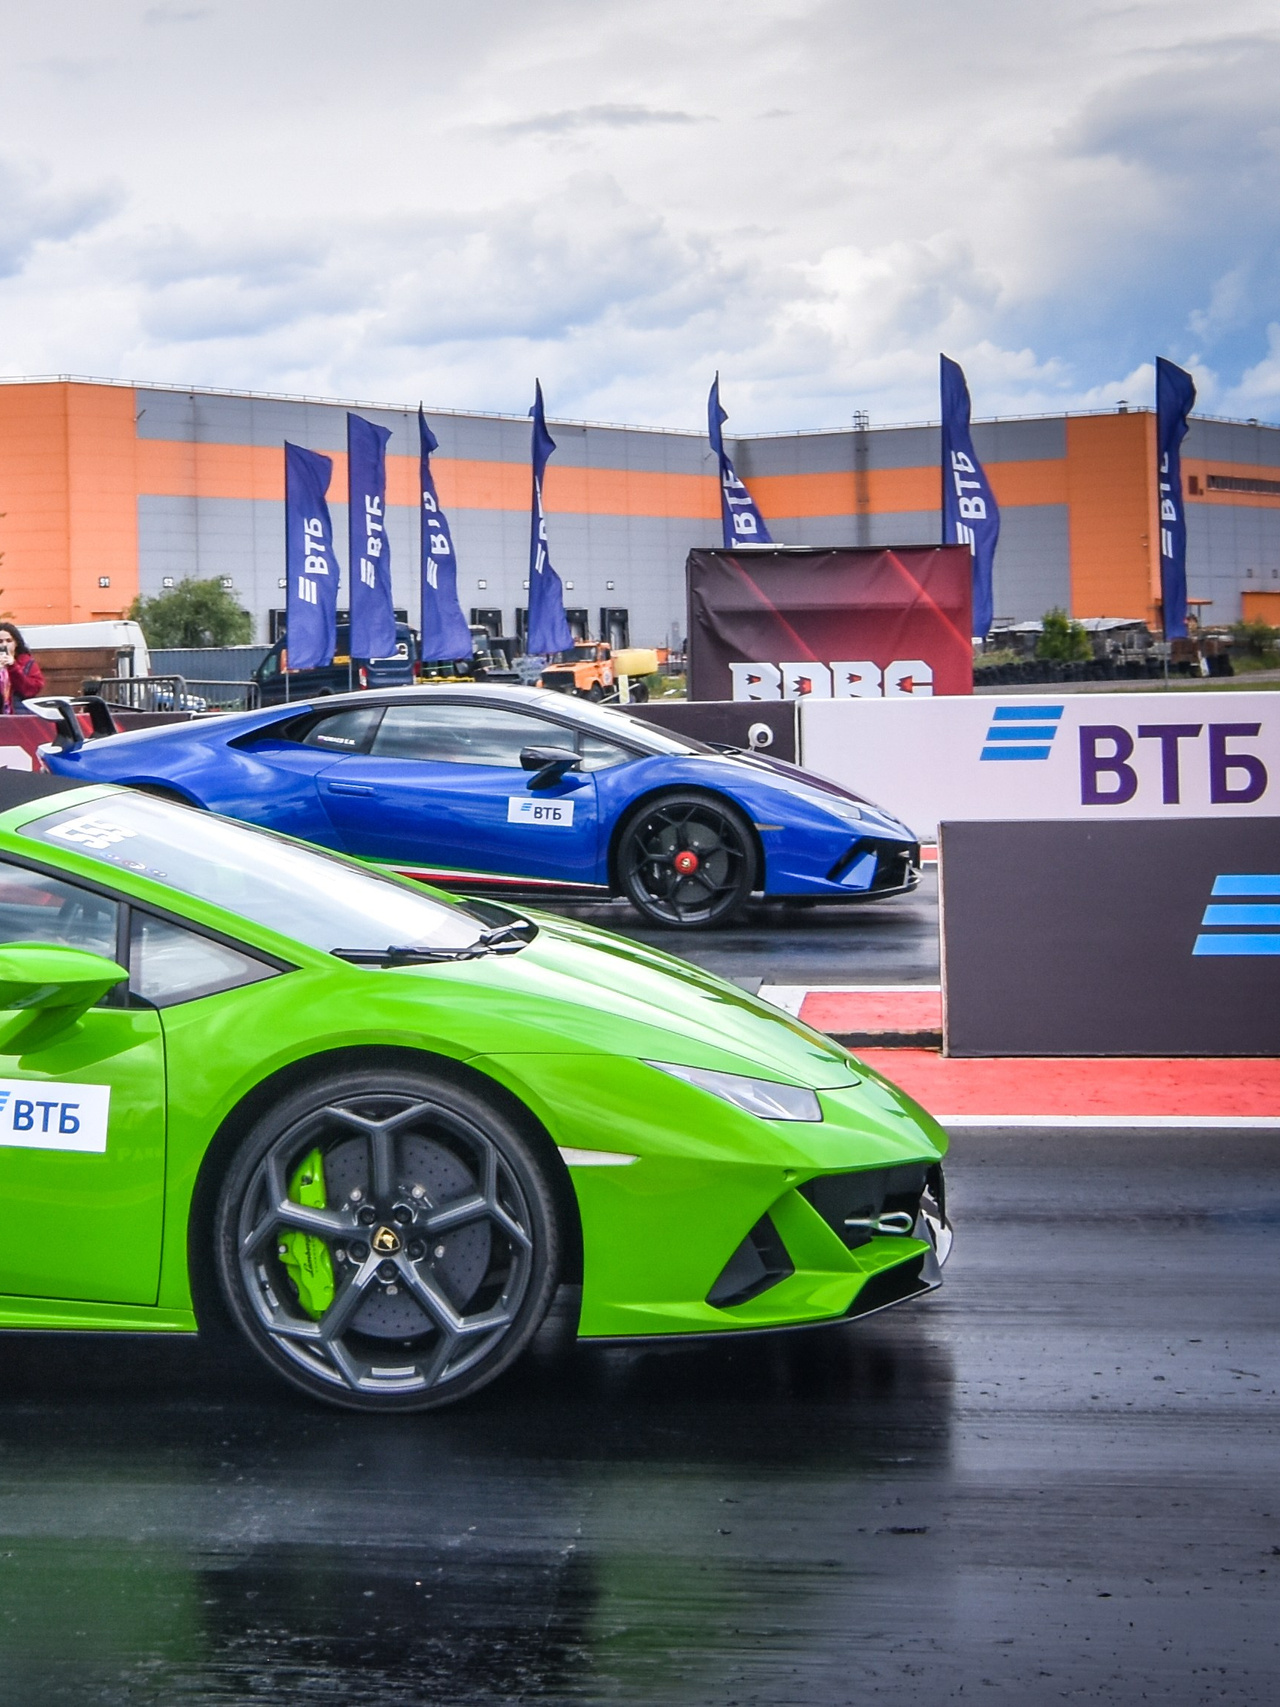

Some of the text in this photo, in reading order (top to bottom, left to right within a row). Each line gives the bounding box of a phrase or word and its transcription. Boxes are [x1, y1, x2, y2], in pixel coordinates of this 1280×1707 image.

[951, 450, 987, 519] ВТБ
[304, 517, 330, 575] ВТБ
[1078, 722, 1269, 806] ВТБ
[533, 806, 562, 821] ВТБ
[12, 1099, 81, 1135] ВТБ
